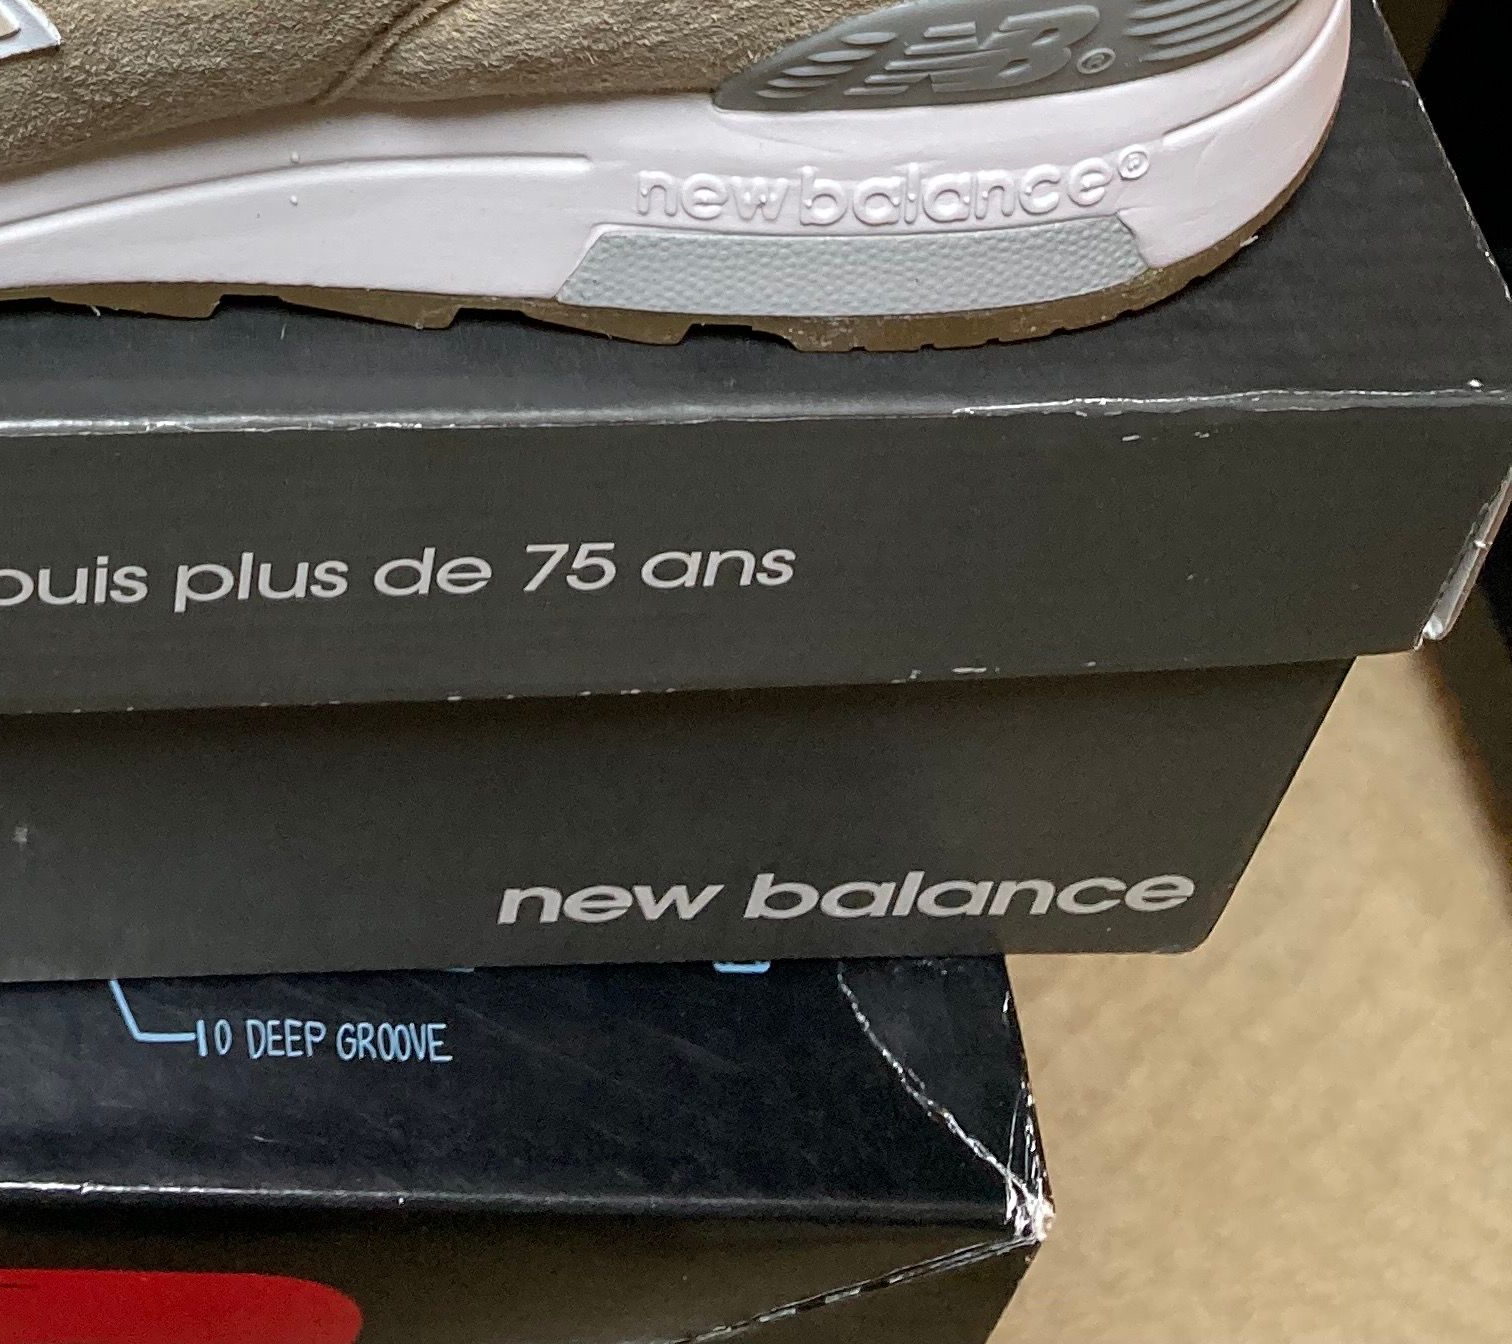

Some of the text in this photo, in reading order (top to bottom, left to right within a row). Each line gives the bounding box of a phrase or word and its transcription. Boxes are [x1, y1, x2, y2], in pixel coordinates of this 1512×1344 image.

[174, 551, 349, 613] plus
[373, 547, 492, 597] de
[523, 542, 617, 592] 75
[641, 549, 796, 589] ans
[497, 870, 1196, 925] new balance
[195, 1018, 453, 1062] 10 DEEP GROOVE
